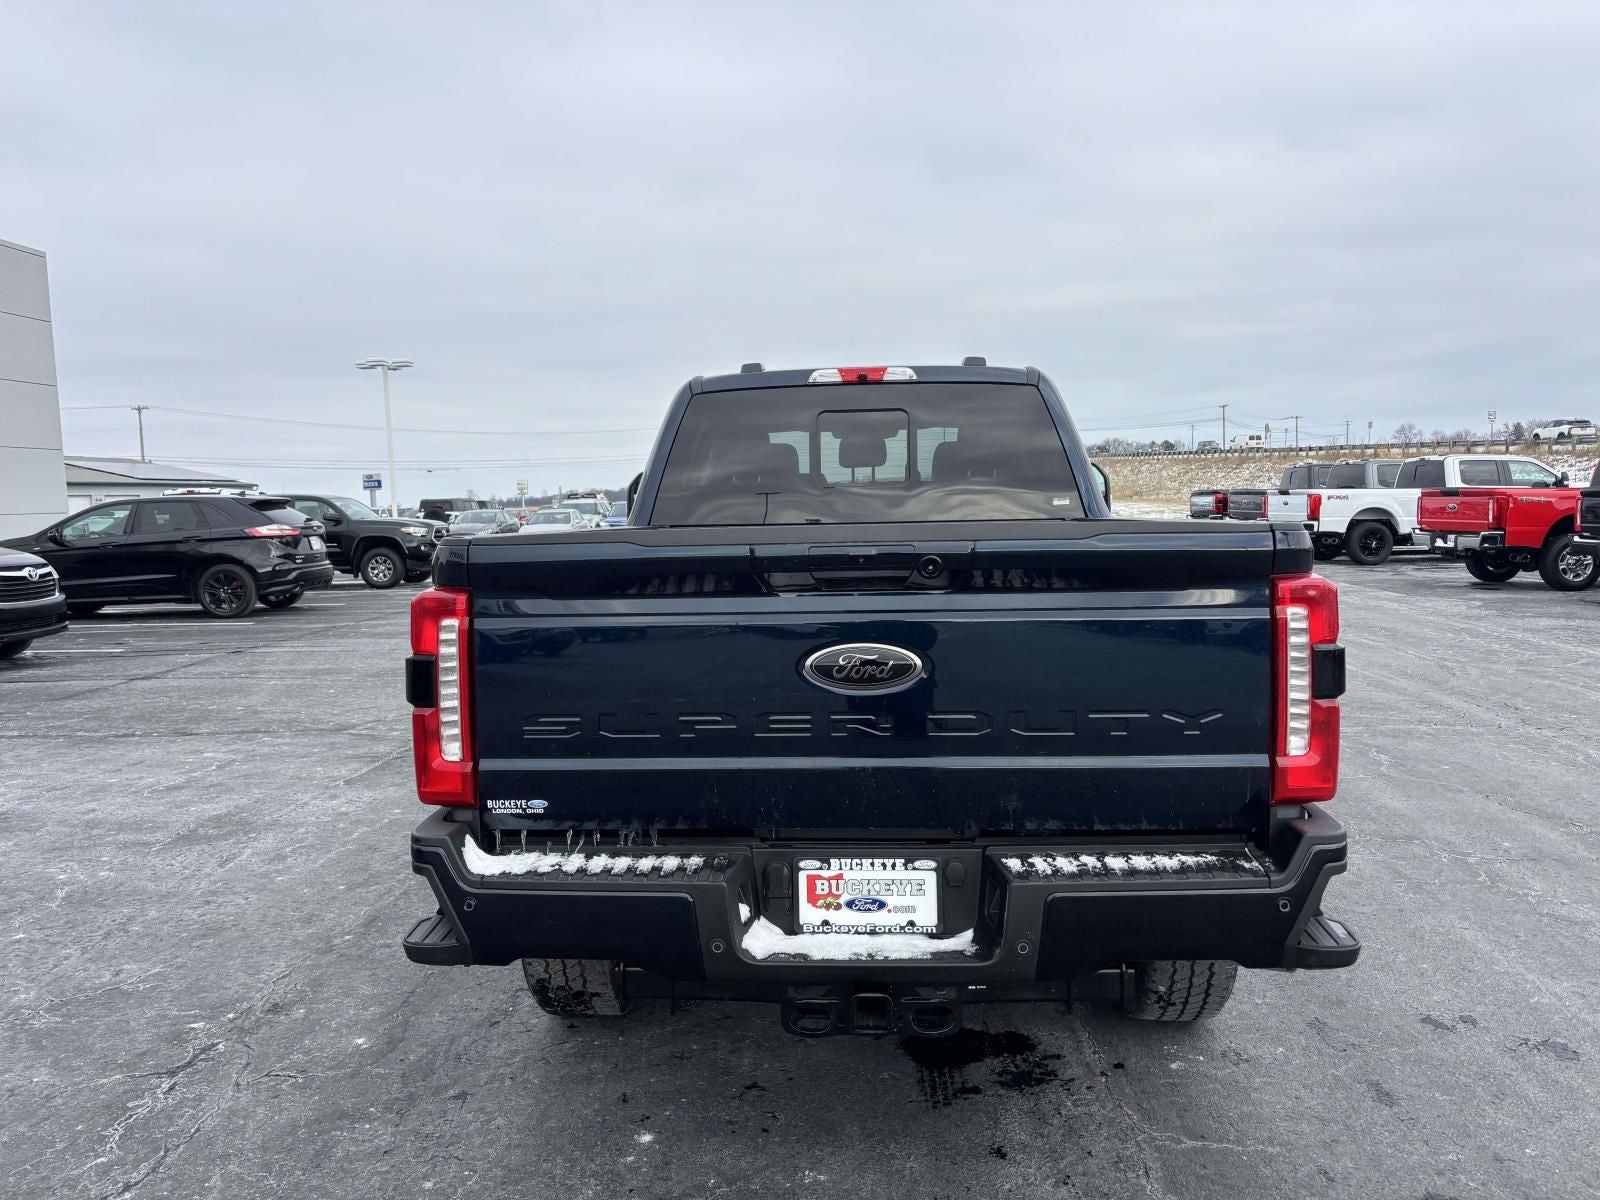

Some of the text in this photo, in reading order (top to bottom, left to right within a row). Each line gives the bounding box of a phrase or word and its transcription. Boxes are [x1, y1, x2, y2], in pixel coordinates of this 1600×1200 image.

[832, 653, 894, 679] Ford
[521, 709, 1225, 739] SUPER DUTY
[487, 799, 527, 808] BUCKEYE
[829, 858, 905, 871] BUCKEYE
[814, 879, 926, 896] BUCKEYE
[851, 898, 917, 914] Ford .com
[802, 923, 937, 934] BuckeyeFord.com
